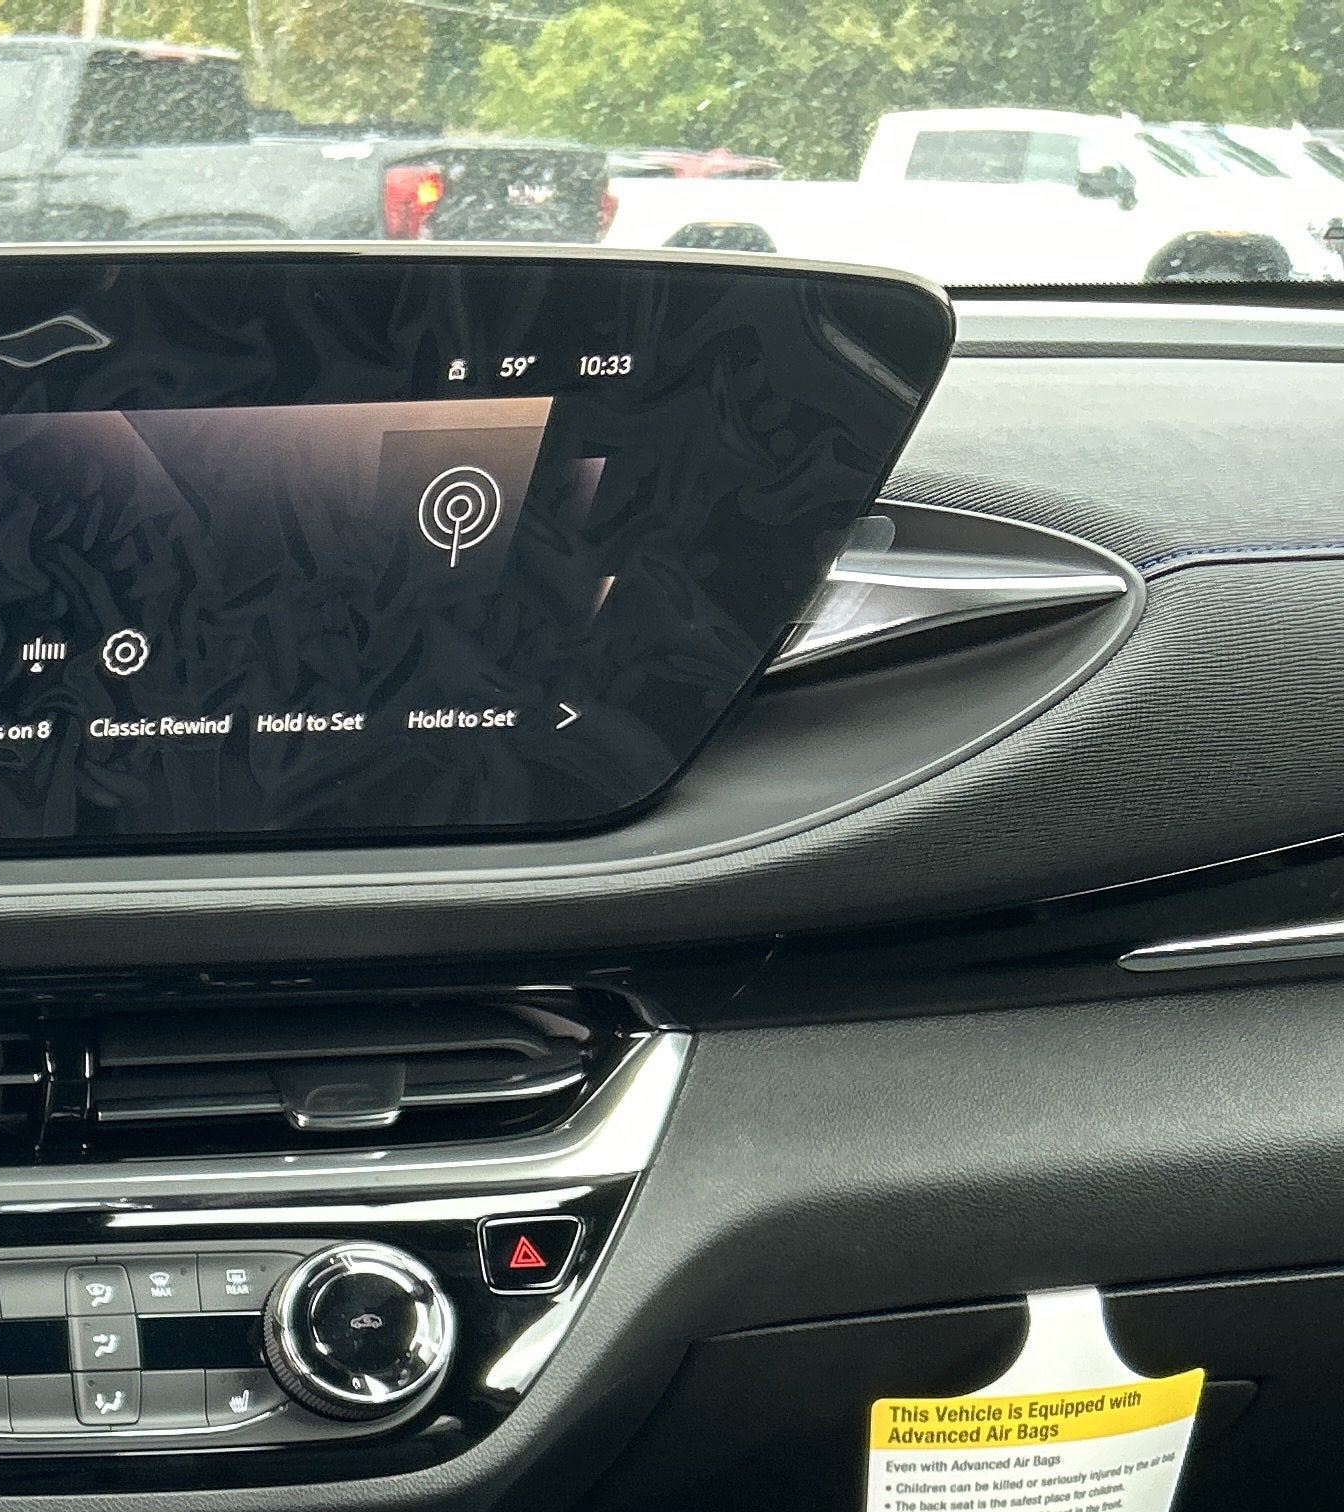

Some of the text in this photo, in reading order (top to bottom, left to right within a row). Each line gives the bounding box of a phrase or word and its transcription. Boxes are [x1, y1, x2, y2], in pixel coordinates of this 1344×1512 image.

[499, 355, 536, 377] 59°
[579, 355, 631, 376] 10:33
[90, 714, 231, 737] Classic Rewind
[257, 712, 364, 732] Hold to Set
[408, 708, 515, 728] Hold to Set
[8, 724, 33, 740] on
[37, 721, 51, 739] 8
[888, 1390, 1143, 1423] This Vehicle is Equipped with
[887, 1422, 1060, 1444] Advanced Air Bags
[885, 1455, 1061, 1473] Even with Advanced Air Bags
[896, 1482, 947, 1494] Children
[950, 1483, 972, 1493] can
[975, 1481, 990, 1492] be
[992, 1479, 1024, 1491] killed
[1026, 1478, 1038, 1488] or
[1041, 1472, 1088, 1487] seriously
[1089, 1465, 1123, 1482] injured
[895, 1500, 917, 1512] The
[920, 1500, 947, 1512] back
[950, 1499, 974, 1510] seat
[977, 1499, 987, 1509] is
[990, 1498, 1008, 1509] the
[1010, 1494, 1042, 1508] safest
[1044, 1492, 1071, 1505] place
[1073, 1490, 1087, 1499] for
